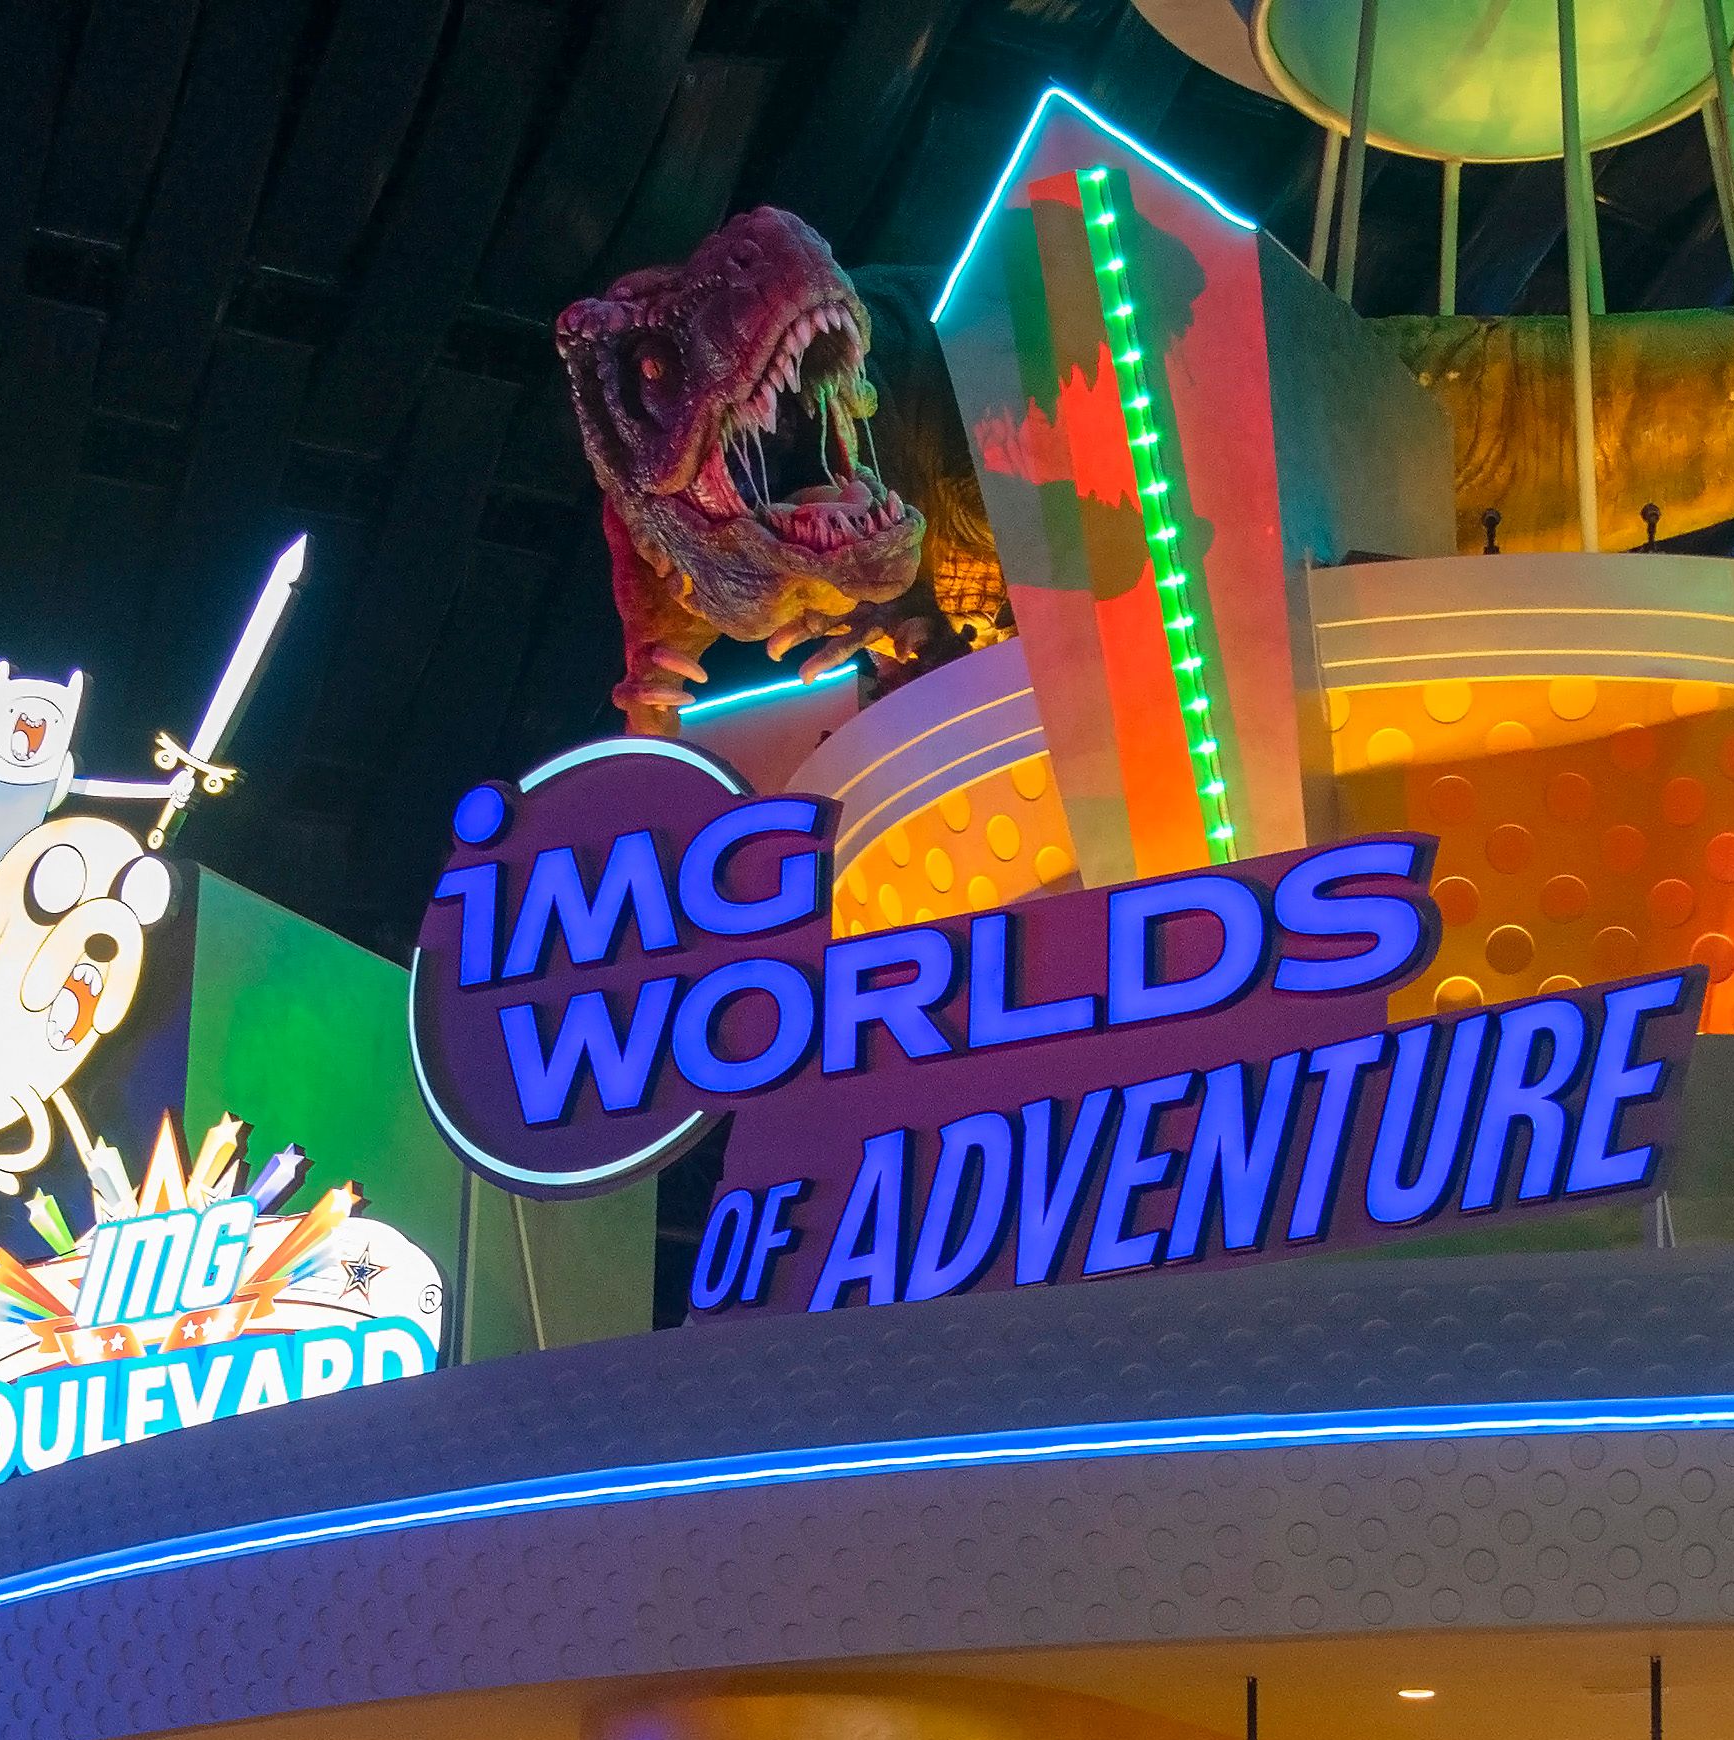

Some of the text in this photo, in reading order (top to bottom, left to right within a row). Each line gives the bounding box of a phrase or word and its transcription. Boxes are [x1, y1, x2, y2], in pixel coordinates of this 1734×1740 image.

[498, 842, 1424, 1129] WORLDS
[75, 1200, 257, 1326] IMG
[691, 976, 1687, 1312] OF ADVENTURE
